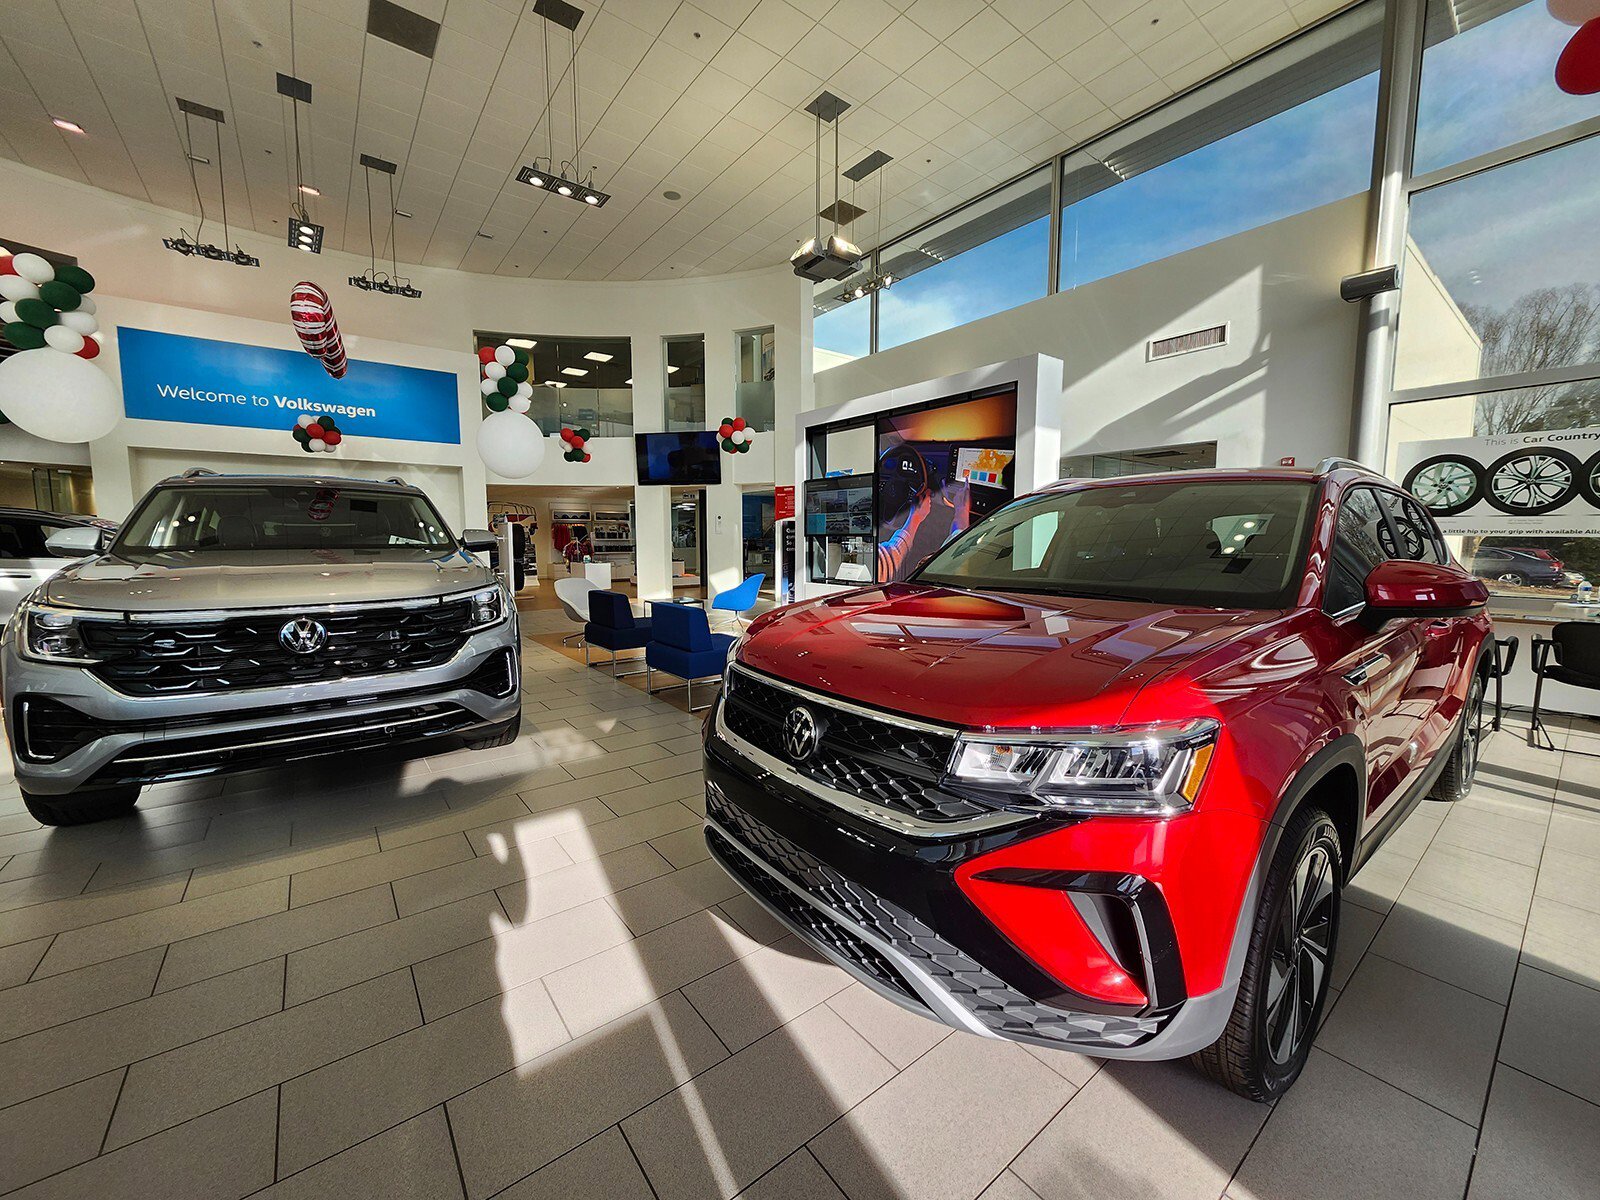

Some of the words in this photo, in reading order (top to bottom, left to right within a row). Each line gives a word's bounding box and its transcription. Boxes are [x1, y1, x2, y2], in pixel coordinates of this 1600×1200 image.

[156, 383, 248, 406] Welcome
[251, 394, 270, 408] to
[273, 395, 377, 418] Volkswagen
[1484, 438, 1507, 447] This
[1523, 435, 1544, 444] Car
[1547, 432, 1600, 442] Country
[1448, 527, 1466, 535] little
[1467, 528, 1480, 537] hip
[1489, 529, 1507, 538] your
[1508, 528, 1525, 538] grip
[1525, 527, 1545, 535] with
[1545, 527, 1583, 535] available
